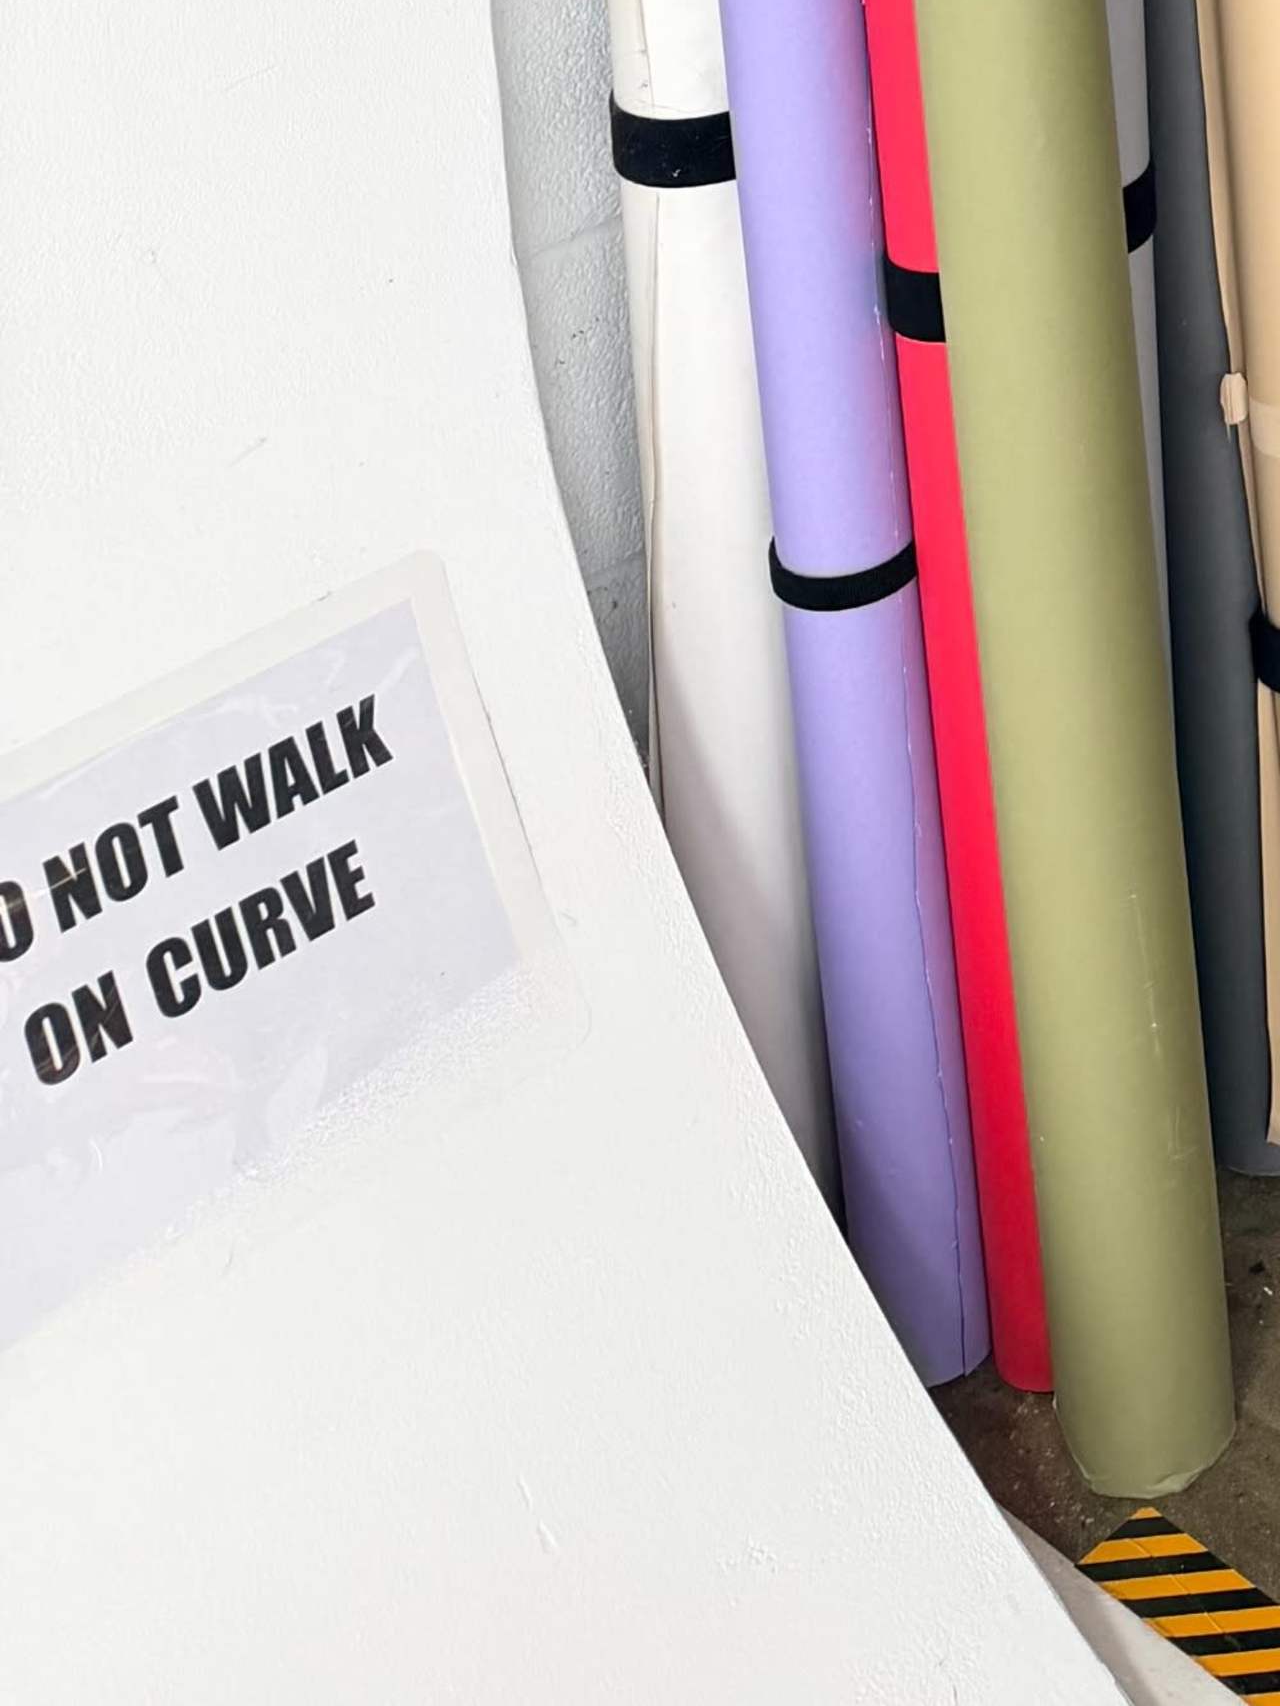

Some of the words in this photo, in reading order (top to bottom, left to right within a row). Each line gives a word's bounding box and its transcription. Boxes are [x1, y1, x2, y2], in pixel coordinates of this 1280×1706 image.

[42, 794, 185, 933] NOT
[192, 693, 393, 851] WALK
[23, 969, 133, 1086] ON
[145, 839, 376, 1018] CURVE
